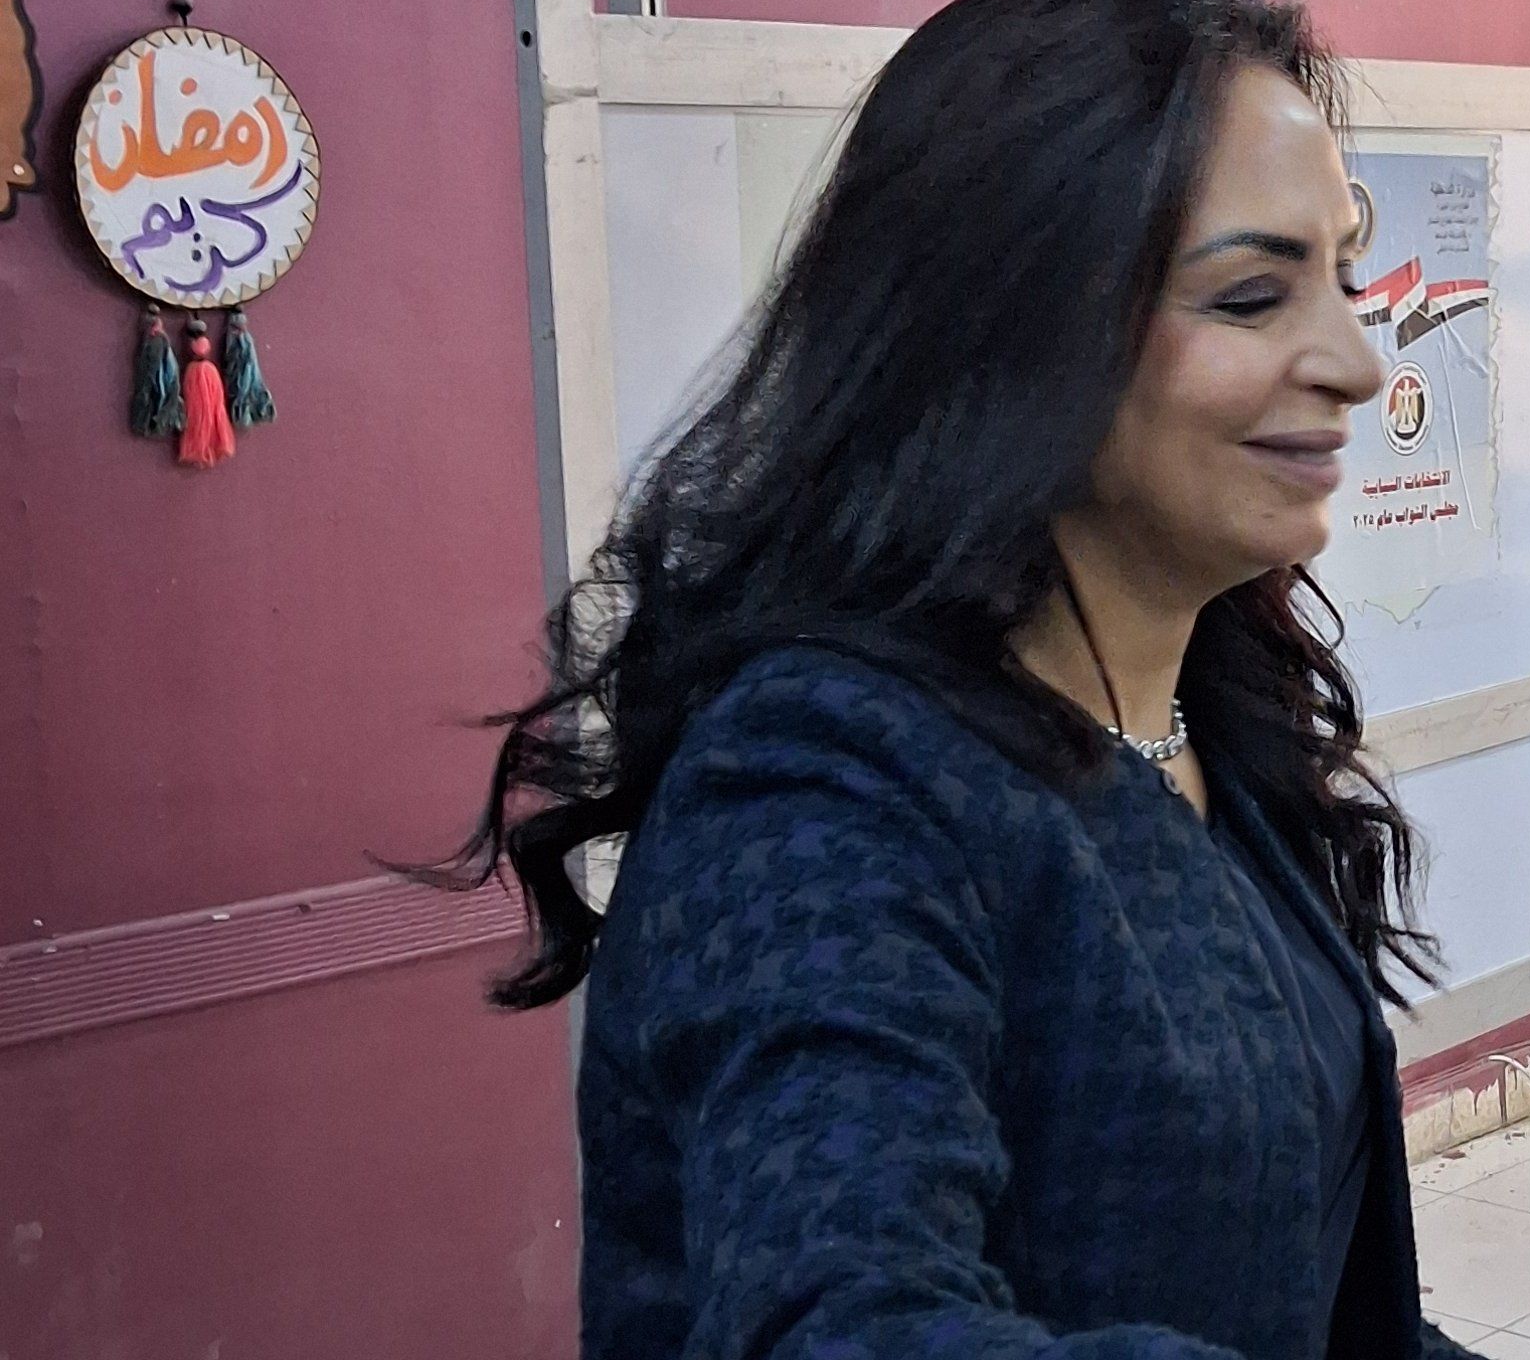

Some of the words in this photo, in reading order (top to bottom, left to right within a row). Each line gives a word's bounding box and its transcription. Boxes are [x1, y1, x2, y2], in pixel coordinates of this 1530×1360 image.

[89, 50, 288, 193] رمضان
[120, 160, 302, 292] كريم
[1361, 475, 1401, 499] النيابية
[1403, 470, 1451, 493] الانتخابات
[1352, 513, 1375, 528] ٢٠٢٥
[1376, 508, 1393, 531] عام
[1395, 503, 1428, 527] النواب
[1429, 500, 1459, 521] مجلس
